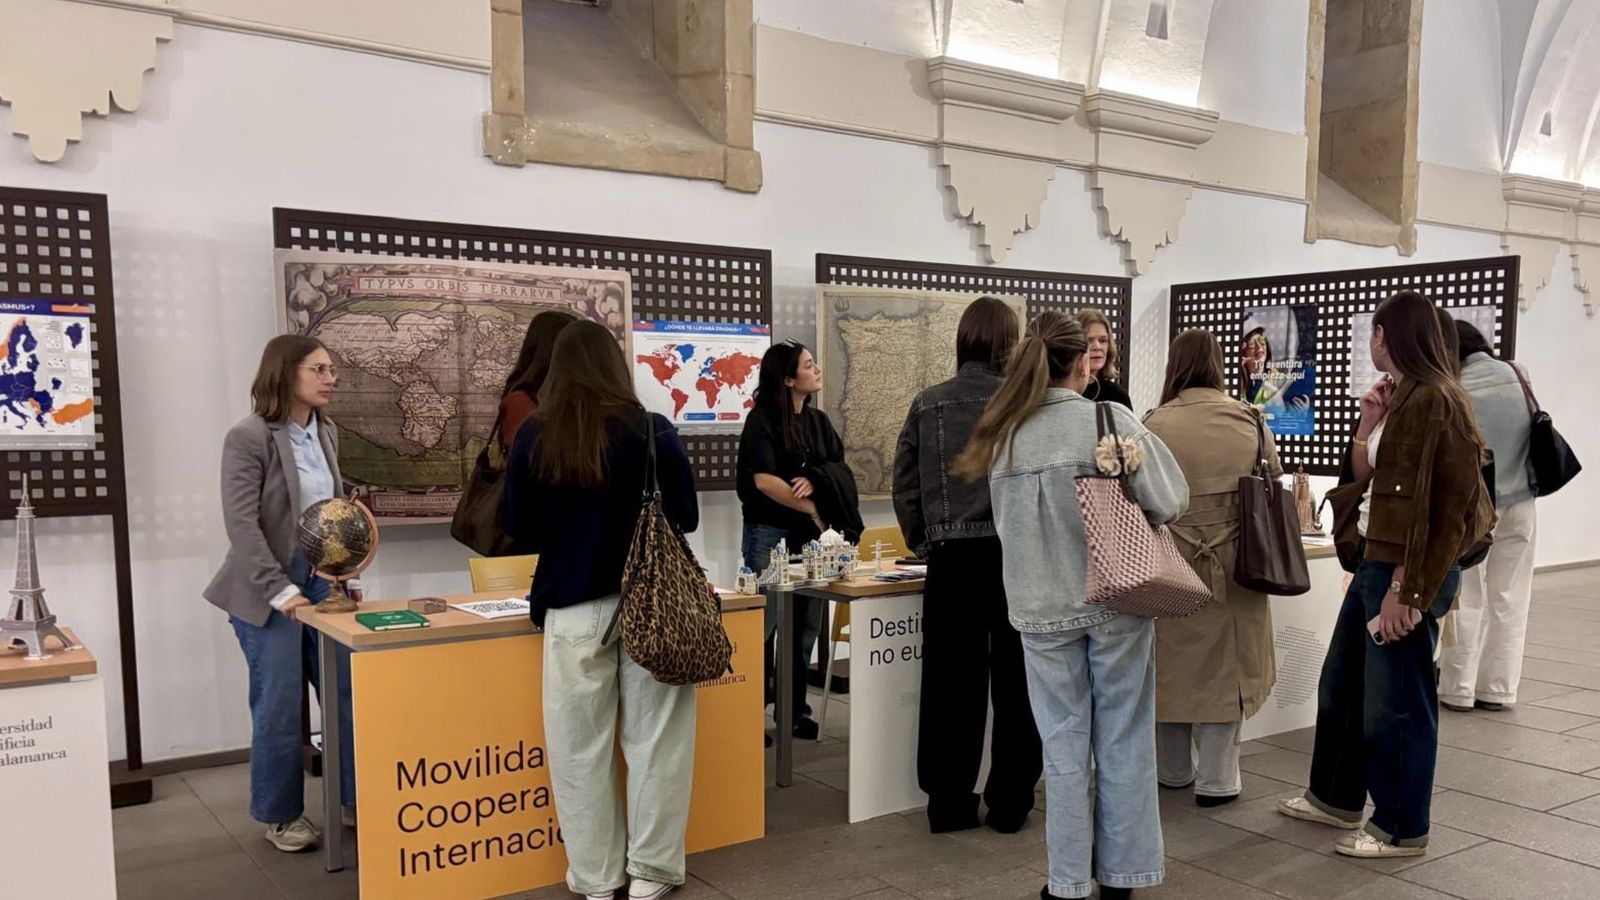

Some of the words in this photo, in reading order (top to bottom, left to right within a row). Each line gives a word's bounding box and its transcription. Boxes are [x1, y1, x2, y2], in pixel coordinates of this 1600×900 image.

[364, 278, 415, 288] TYPVS
[424, 280, 470, 292] ORBIS
[1266, 361, 1302, 369] aventura
[870, 612, 923, 639] Desti
[870, 648, 895, 666] no
[0, 716, 53, 734] ersidad
[396, 740, 544, 791] Movilida
[397, 785, 550, 833] Coopera
